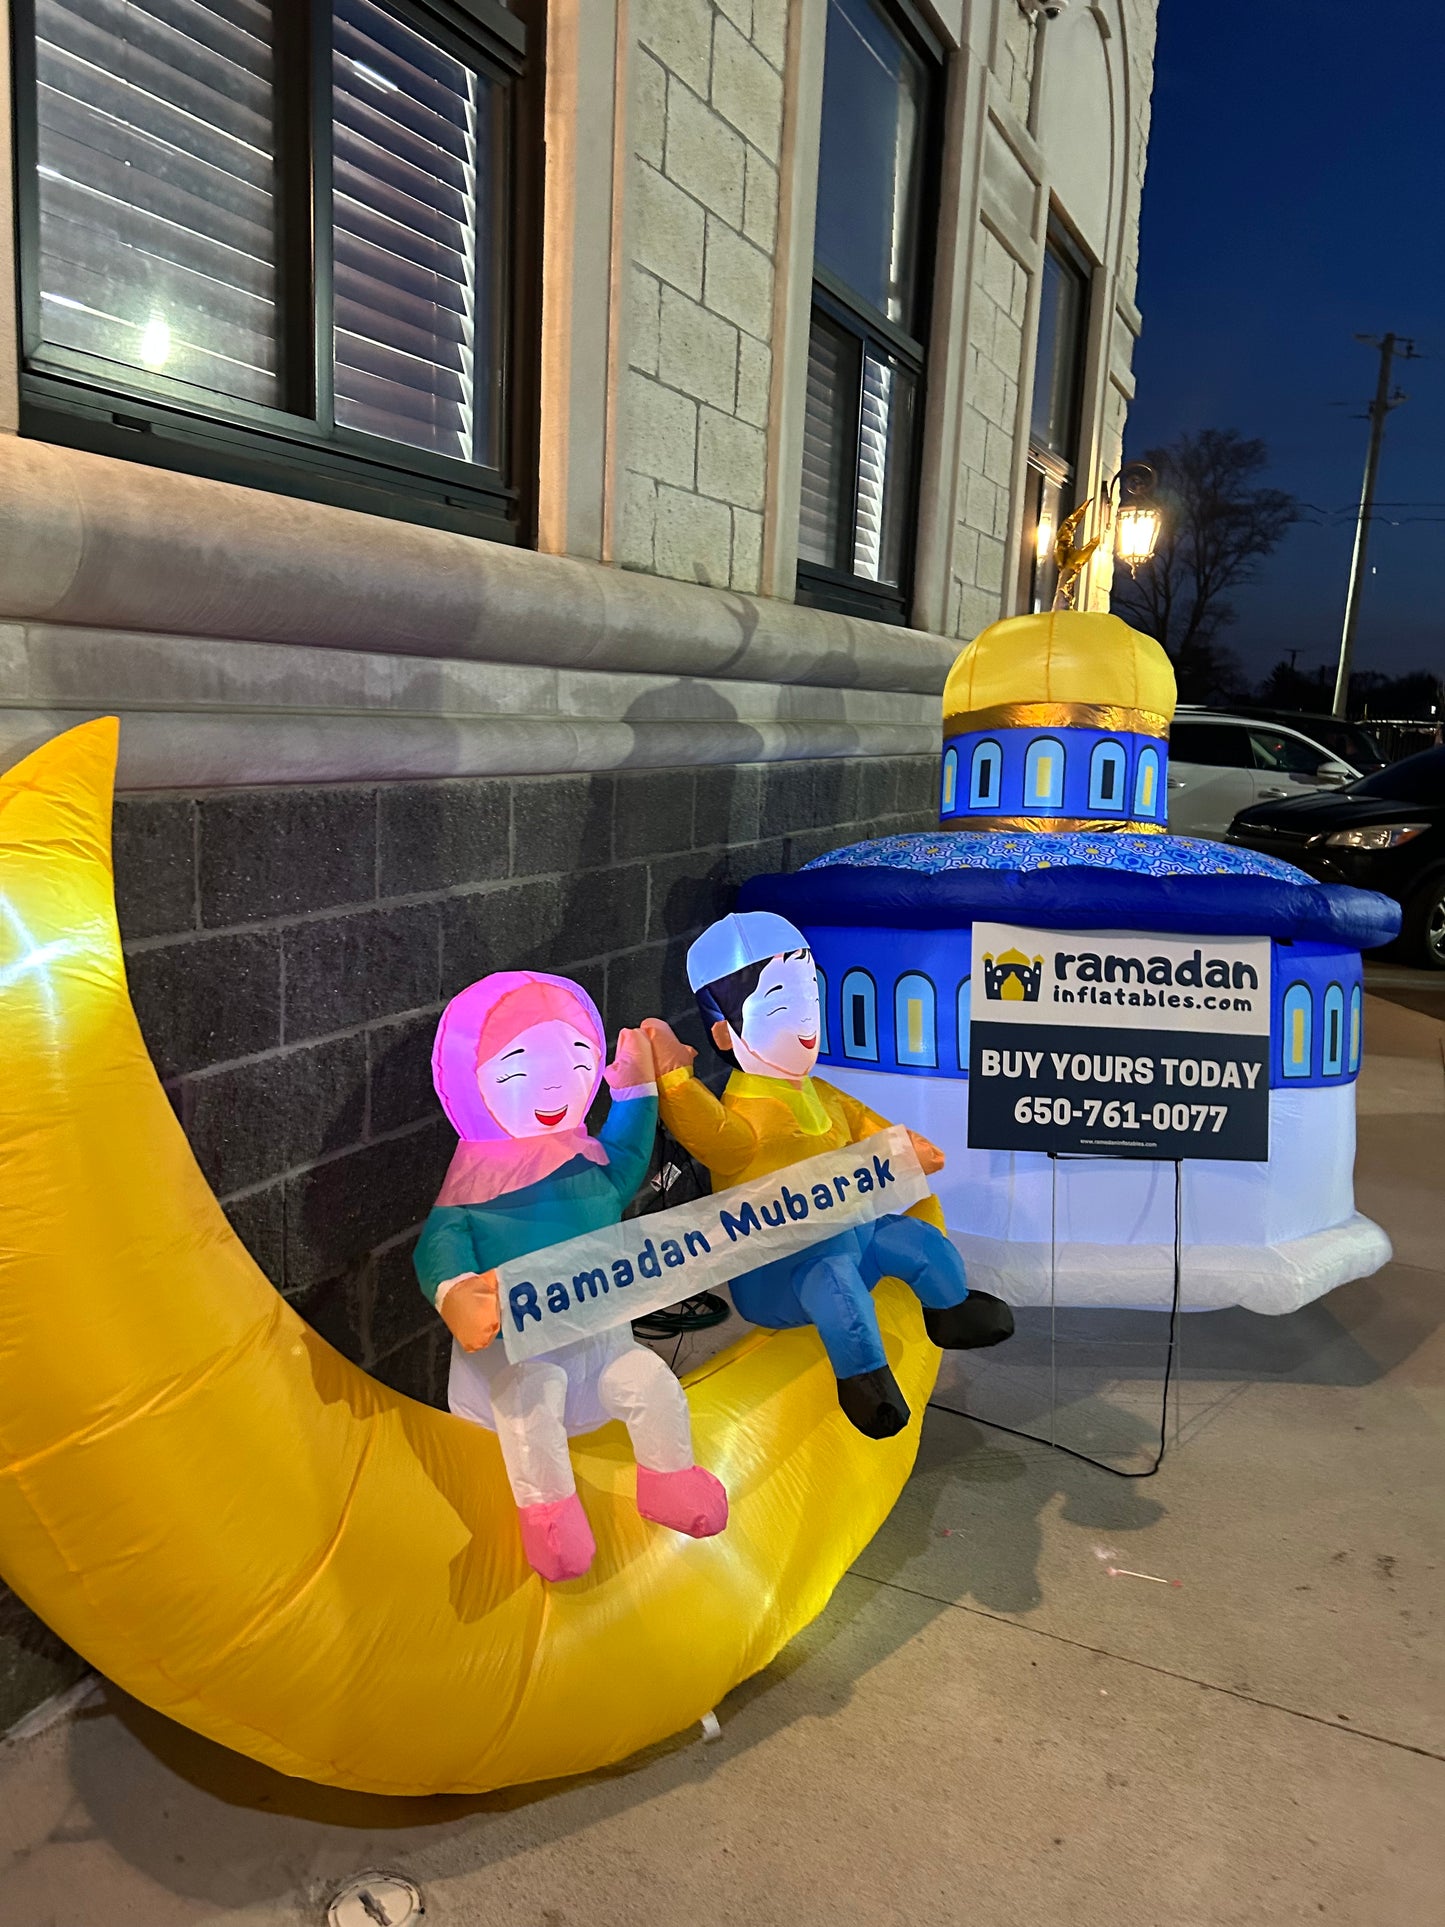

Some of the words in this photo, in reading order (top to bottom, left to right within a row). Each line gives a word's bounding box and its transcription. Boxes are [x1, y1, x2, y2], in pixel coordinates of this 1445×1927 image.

[1054, 950, 1259, 990] ramadan
[1053, 985, 1252, 1012] inflatables.com
[981, 1049, 1044, 1079] BUY
[1050, 1052, 1154, 1084] YOURS
[1161, 1058, 1262, 1089] TODAY
[1014, 1096, 1228, 1132] 650-761-0077
[508, 1229, 711, 1333] Ramadan
[719, 1155, 896, 1242] Mubarak
